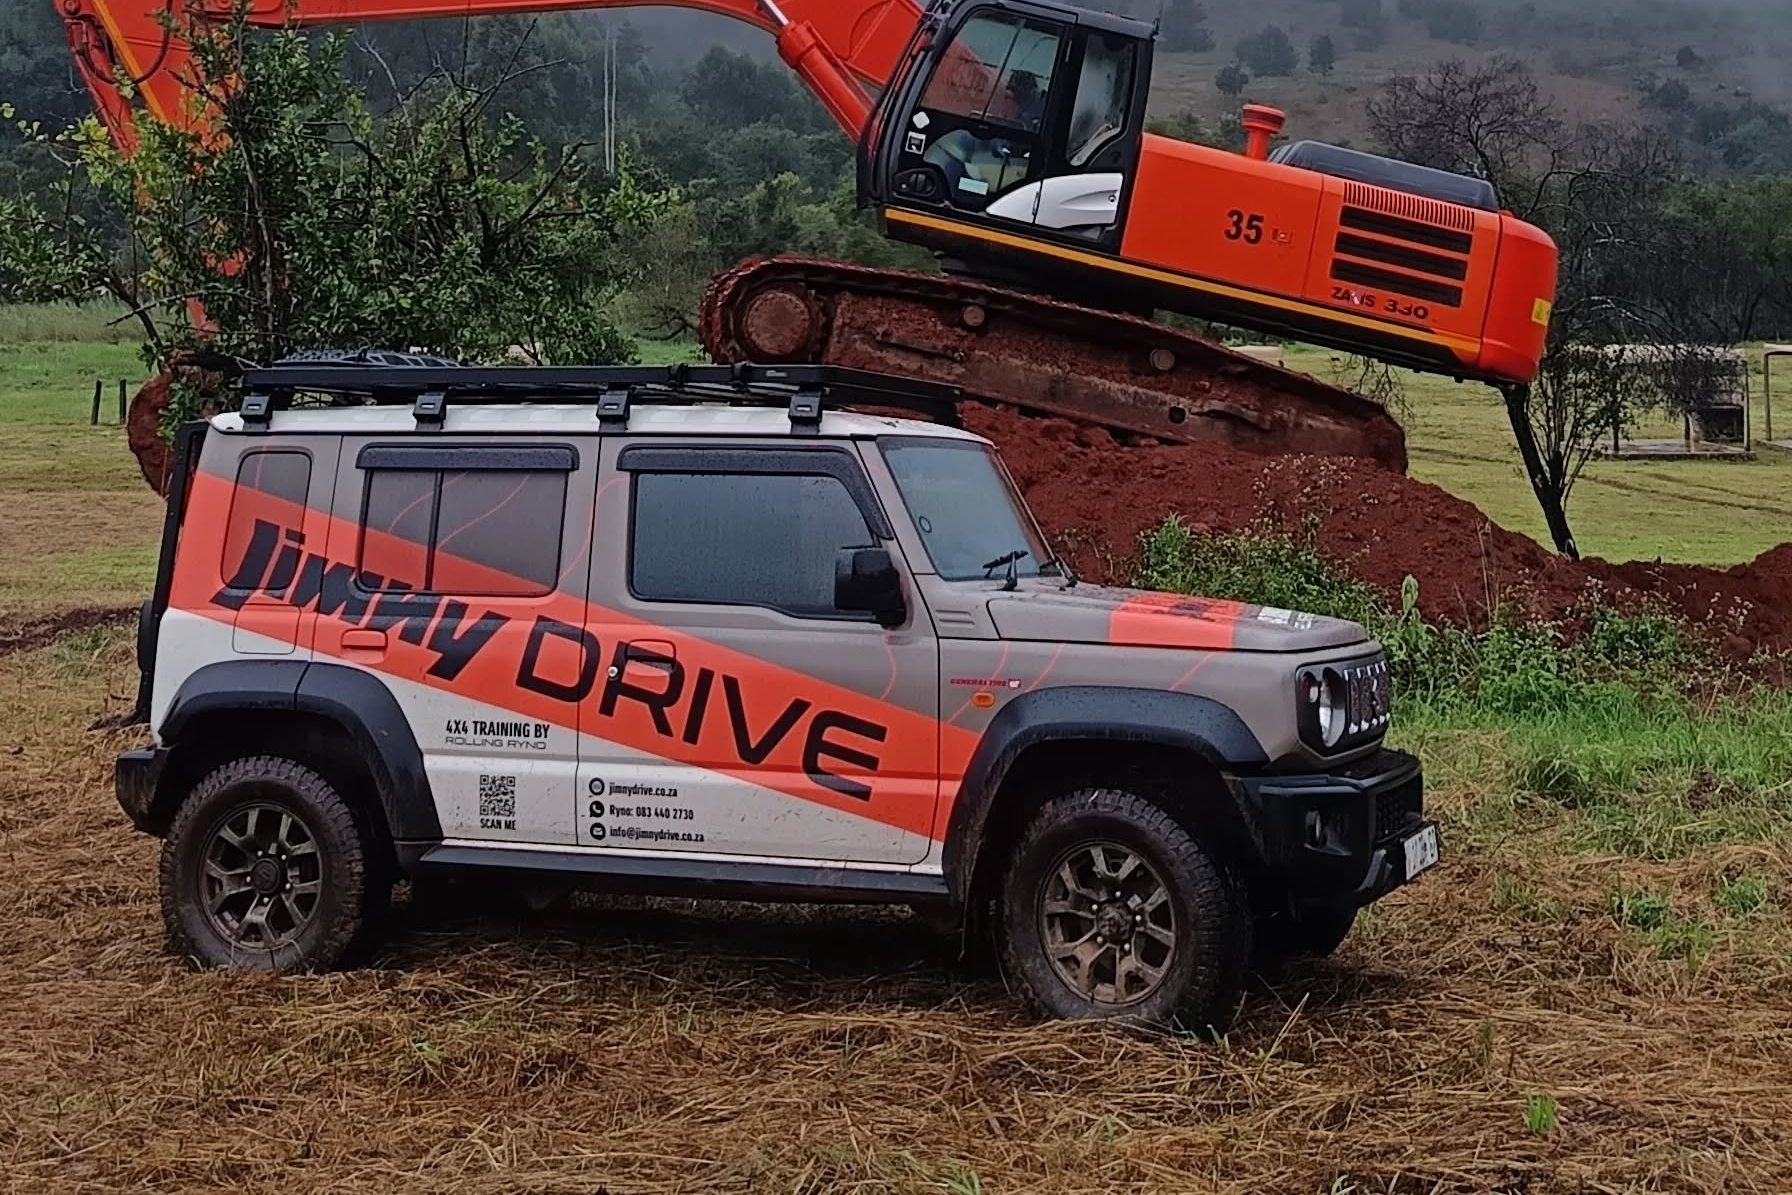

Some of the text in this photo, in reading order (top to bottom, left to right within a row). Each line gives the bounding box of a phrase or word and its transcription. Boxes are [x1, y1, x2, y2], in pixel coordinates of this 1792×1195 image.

[1224, 209, 1264, 244] 35
[1331, 286, 1376, 307] ZAIS
[515, 615, 887, 801] DRIVE
[446, 719, 550, 738] 4X4 TRAINING BY
[445, 736, 546, 750] ROLLING RYNO
[609, 782, 678, 797] jimnydrive.co.za
[609, 804, 694, 821] Ryno: 083 440 2730
[480, 818, 516, 830] SCAN ME
[609, 826, 705, 843] info@jimnydrive.co.za
